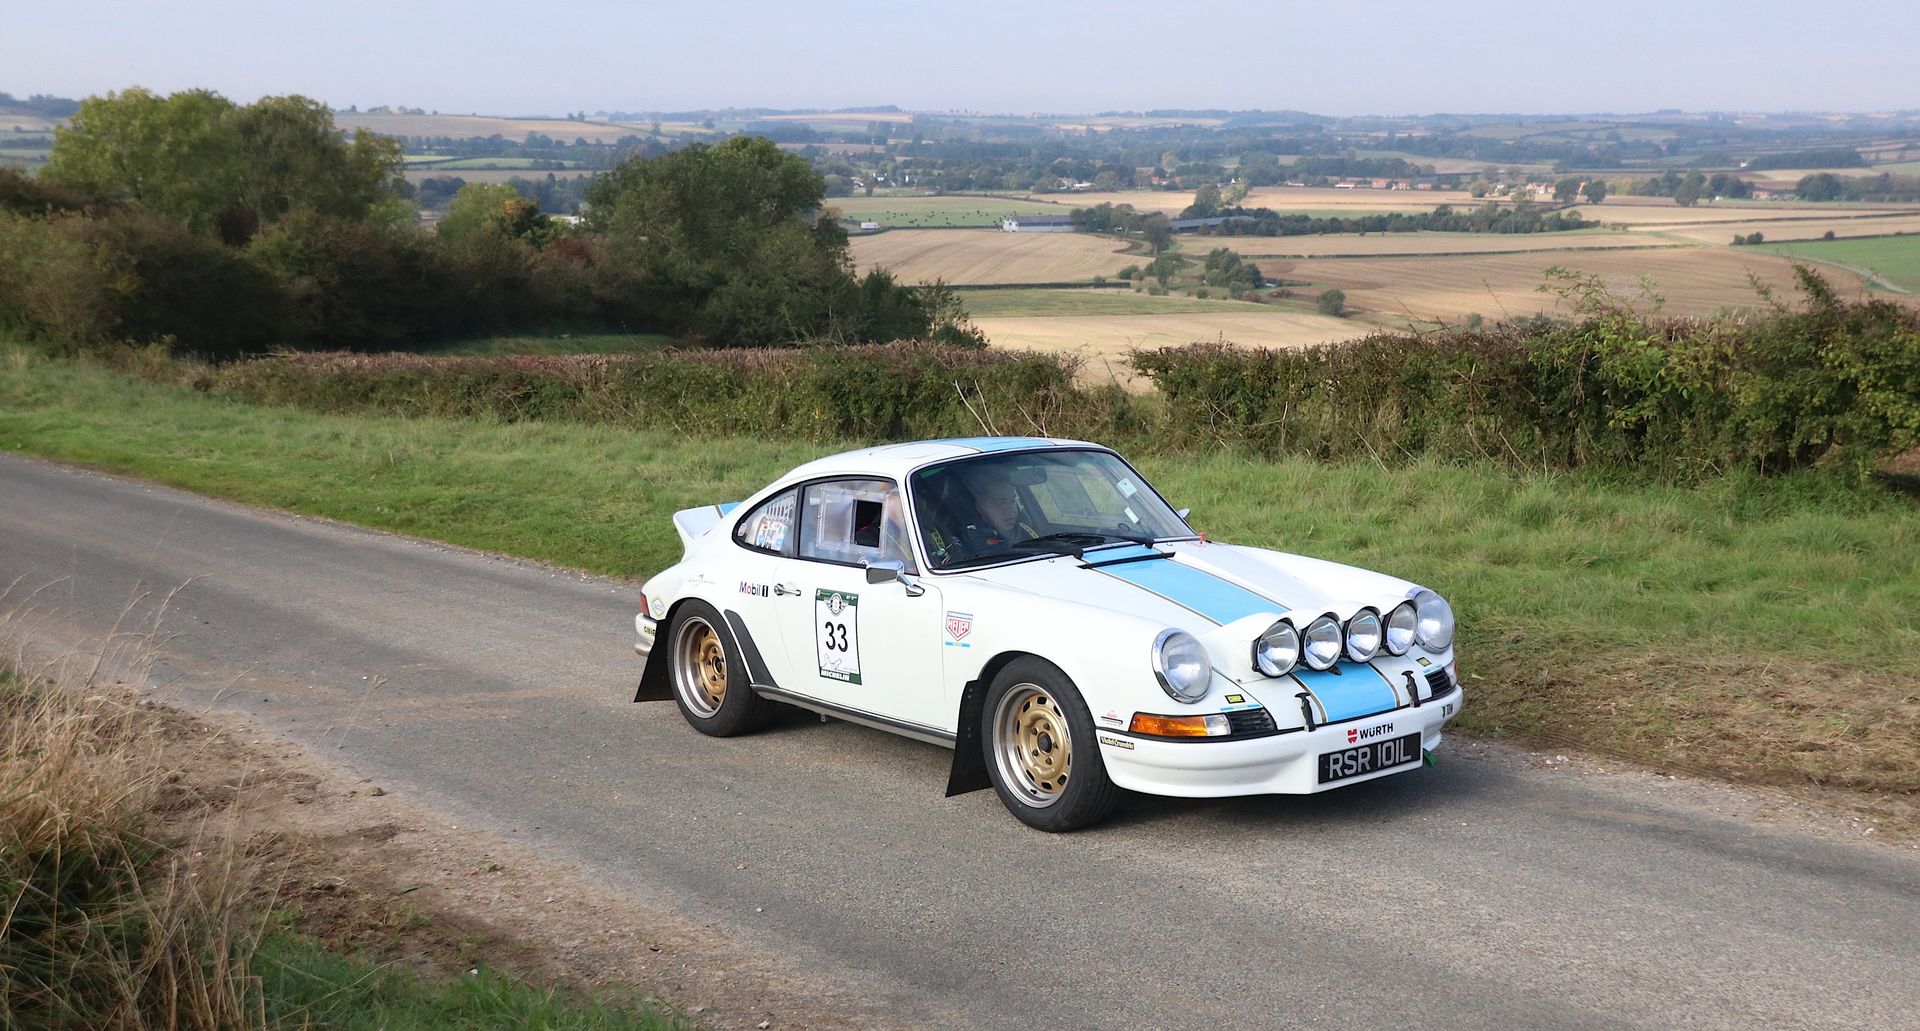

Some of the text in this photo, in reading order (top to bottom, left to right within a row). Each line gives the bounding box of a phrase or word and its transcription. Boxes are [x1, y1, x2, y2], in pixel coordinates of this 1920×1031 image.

[739, 580, 760, 596] Mobil
[825, 621, 848, 652] 33
[947, 618, 970, 637] HEUER
[820, 669, 850, 681] MICHELIN
[1360, 723, 1394, 740] WÜRTH
[1329, 747, 1371, 779] RSR
